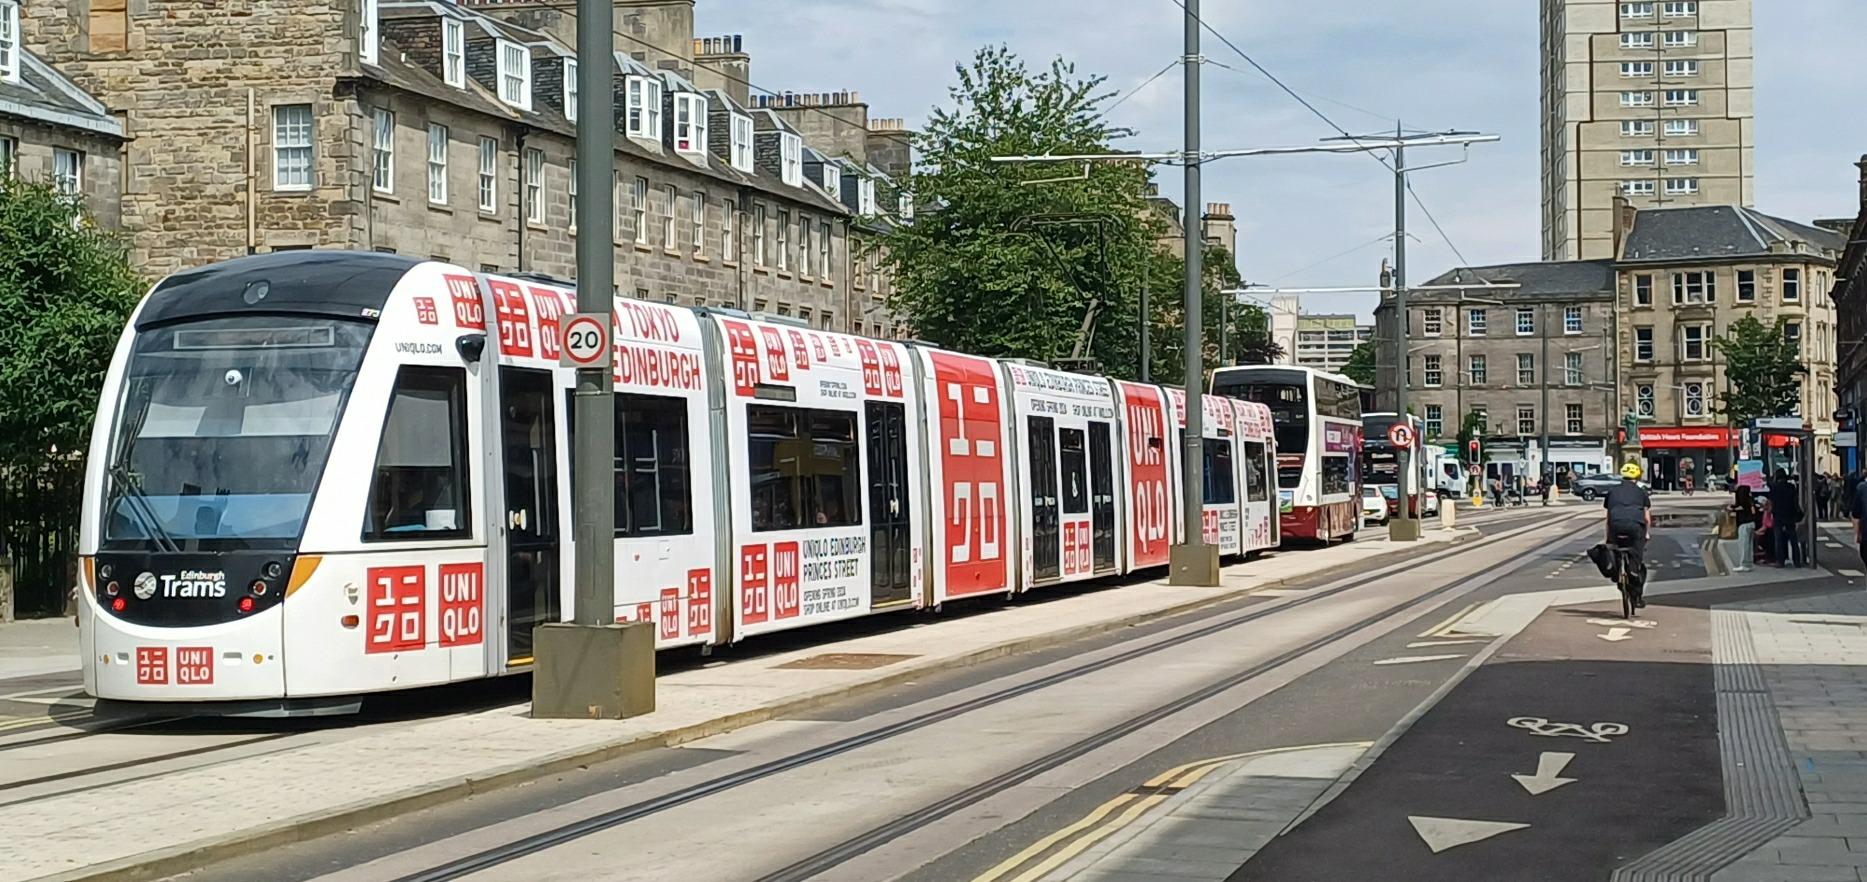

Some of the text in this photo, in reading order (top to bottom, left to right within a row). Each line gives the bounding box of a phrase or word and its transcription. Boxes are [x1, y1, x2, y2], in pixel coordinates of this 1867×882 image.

[449, 279, 478, 299] UNI
[495, 287, 526, 315] ユニ
[456, 302, 482, 324] QLO
[621, 301, 680, 342] TOKYO
[502, 321, 530, 348] クロ
[541, 325, 560, 357] QL
[570, 331, 599, 349] 20
[729, 328, 755, 355] ユニ
[612, 345, 702, 391] EDINBURGH
[769, 354, 787, 378] QLO
[947, 383, 995, 456] ユニ
[1130, 405, 1160, 465] UNI
[952, 482, 999, 564] クロ
[1136, 480, 1165, 553] QLO
[181, 570, 225, 581] Edinburgh
[744, 553, 765, 582] ユニ
[776, 551, 796, 577] UNI
[834, 558, 859, 579] STREET
[160, 575, 226, 598] Trams
[376, 576, 420, 606] ユニ
[443, 573, 477, 602] UNI
[690, 576, 709, 599] ユニ
[776, 582, 798, 614] QLO
[743, 586, 765, 615] クロ
[373, 611, 420, 643] クロ
[443, 606, 480, 642] QLO
[662, 615, 678, 637] QLO
[690, 604, 709, 628] クロ
[140, 651, 164, 665] ユニ
[180, 651, 207, 665] UNI
[140, 667, 165, 681] クロ
[180, 667, 210, 682] QLO
